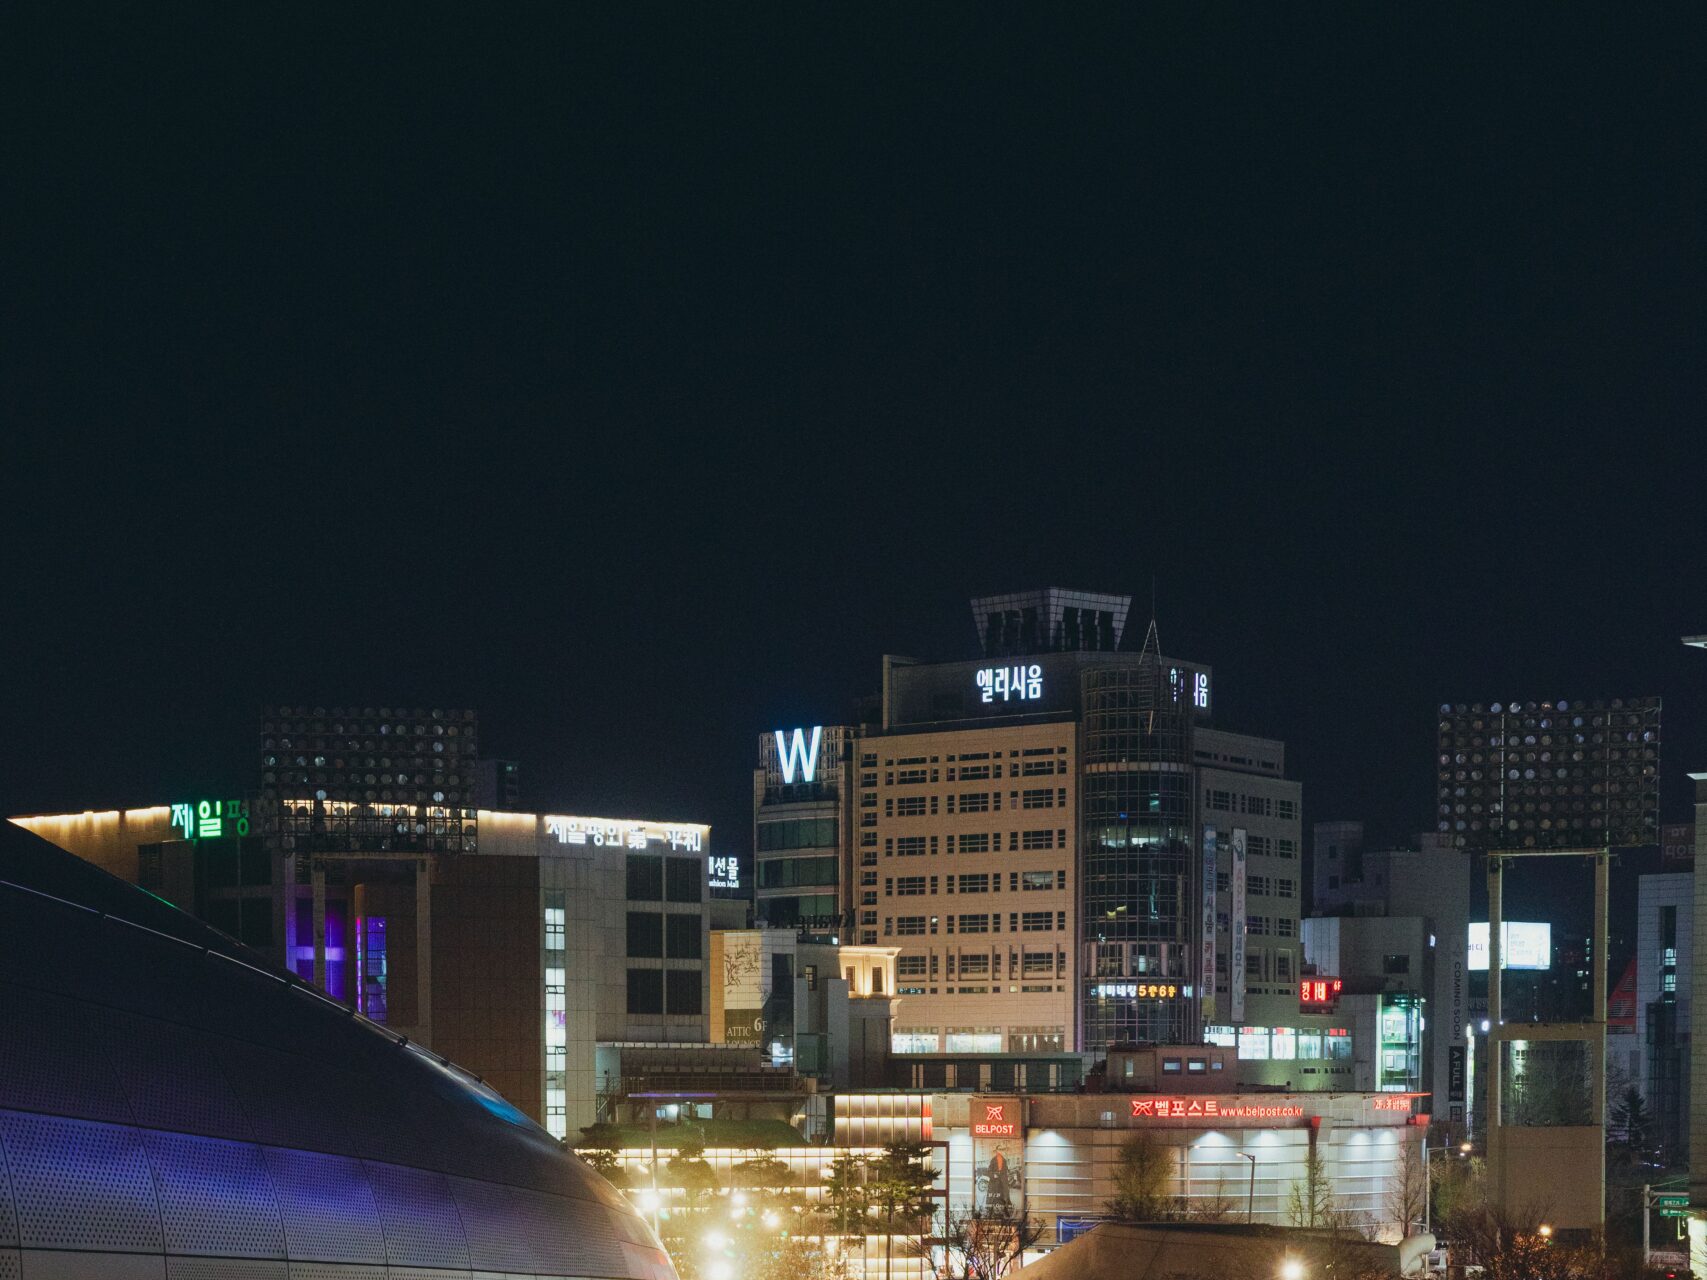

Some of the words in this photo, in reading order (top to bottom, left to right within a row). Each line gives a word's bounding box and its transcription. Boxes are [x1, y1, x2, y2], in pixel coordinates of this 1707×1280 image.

[976, 664, 1043, 703] 엘리시움
[775, 725, 823, 784] W
[1453, 961, 1462, 1007] COMING
[727, 1026, 752, 1037] ATTIC
[754, 1017, 768, 1032] 6F
[1453, 1010, 1462, 1041] SOON
[1155, 1100, 1218, 1117] 벨포스트
[1220, 1104, 1304, 1119] www.belpost.co.kr
[975, 1124, 1014, 1134] BELPOST
